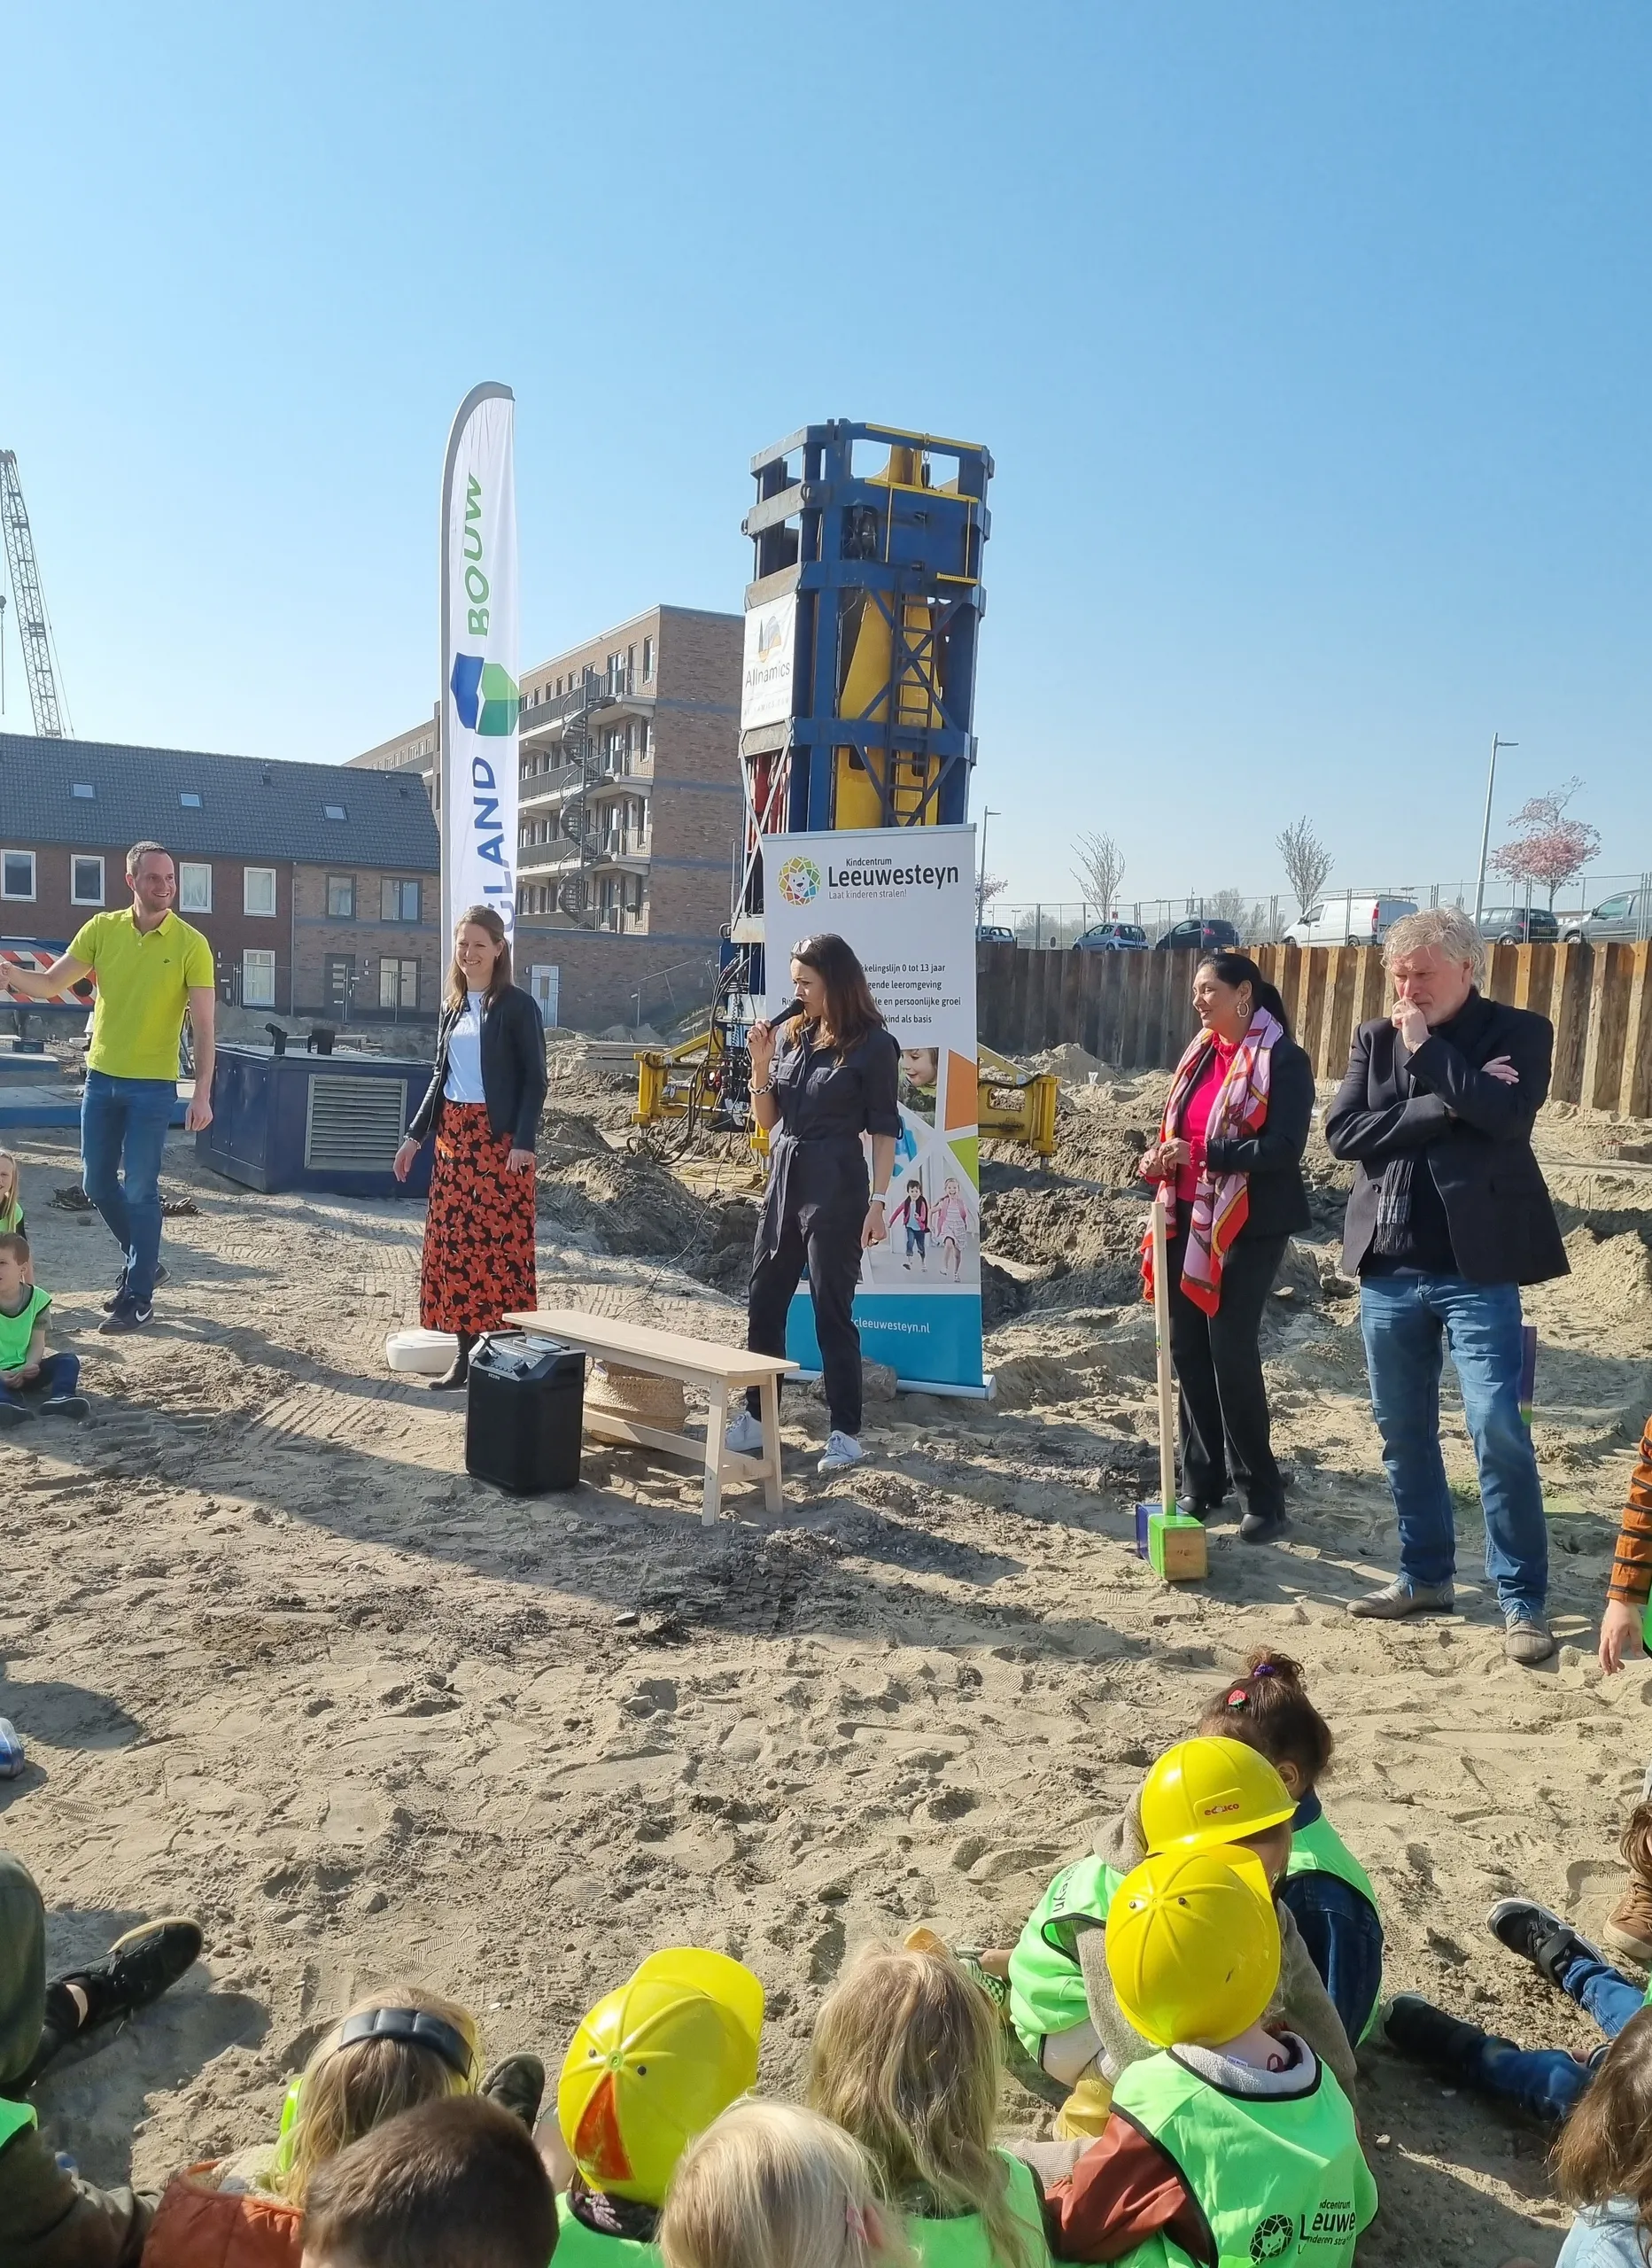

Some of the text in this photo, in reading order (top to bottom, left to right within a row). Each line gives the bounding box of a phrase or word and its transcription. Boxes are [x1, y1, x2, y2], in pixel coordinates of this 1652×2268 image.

[464, 471, 490, 636] BOUW
[745, 661, 791, 688] Allnamics
[846, 858, 892, 867] Kindcentrum
[828, 864, 958, 890] Leeuwesteyn
[828, 889, 907, 900] Laat kinderen stralen!
[931, 963, 946, 974] jaar
[868, 980, 942, 990] gende leeromgeving
[895, 997, 940, 1007] persoonlijke
[942, 997, 961, 1007] groei
[884, 1014, 932, 1023] kind als basis
